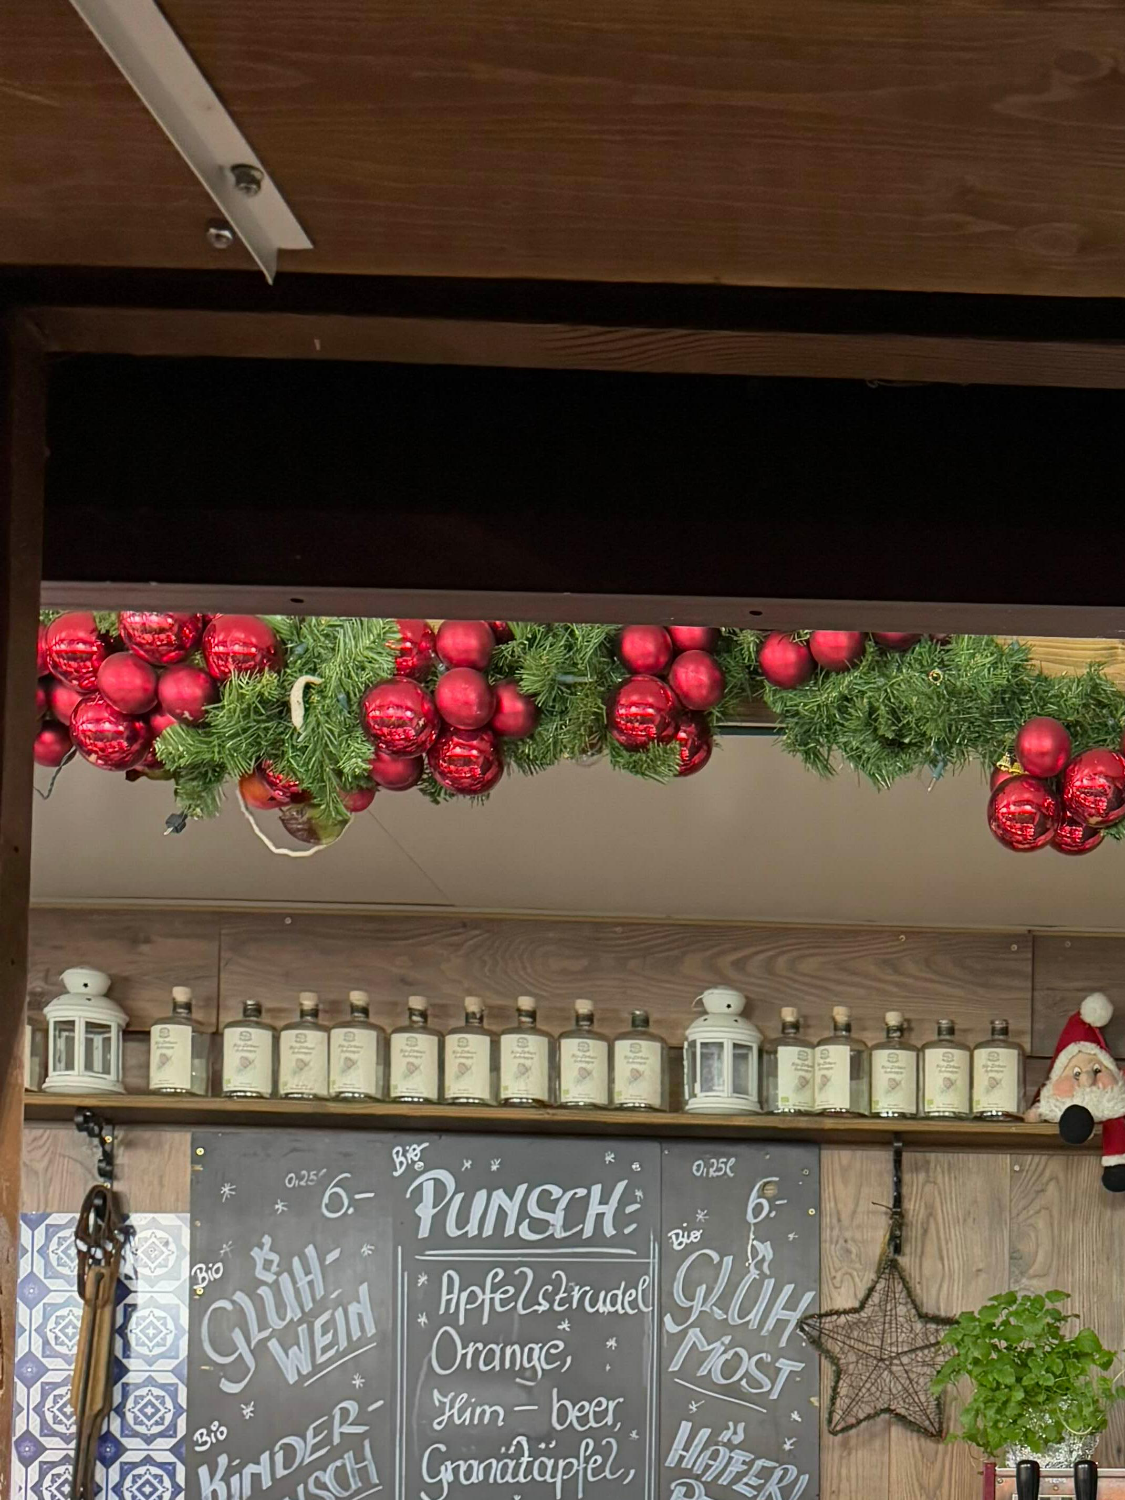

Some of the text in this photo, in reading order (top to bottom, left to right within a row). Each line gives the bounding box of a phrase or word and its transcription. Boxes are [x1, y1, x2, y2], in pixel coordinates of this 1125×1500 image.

[392, 1143, 429, 1176] Bio
[668, 1223, 703, 1250] Bio
[191, 1262, 224, 1288] Bio
[439, 1267, 653, 1325] Apfelstrudel
[431, 1326, 572, 1385] Orange,
[668, 1328, 805, 1399] MOST
[193, 1421, 227, 1451] Bio
